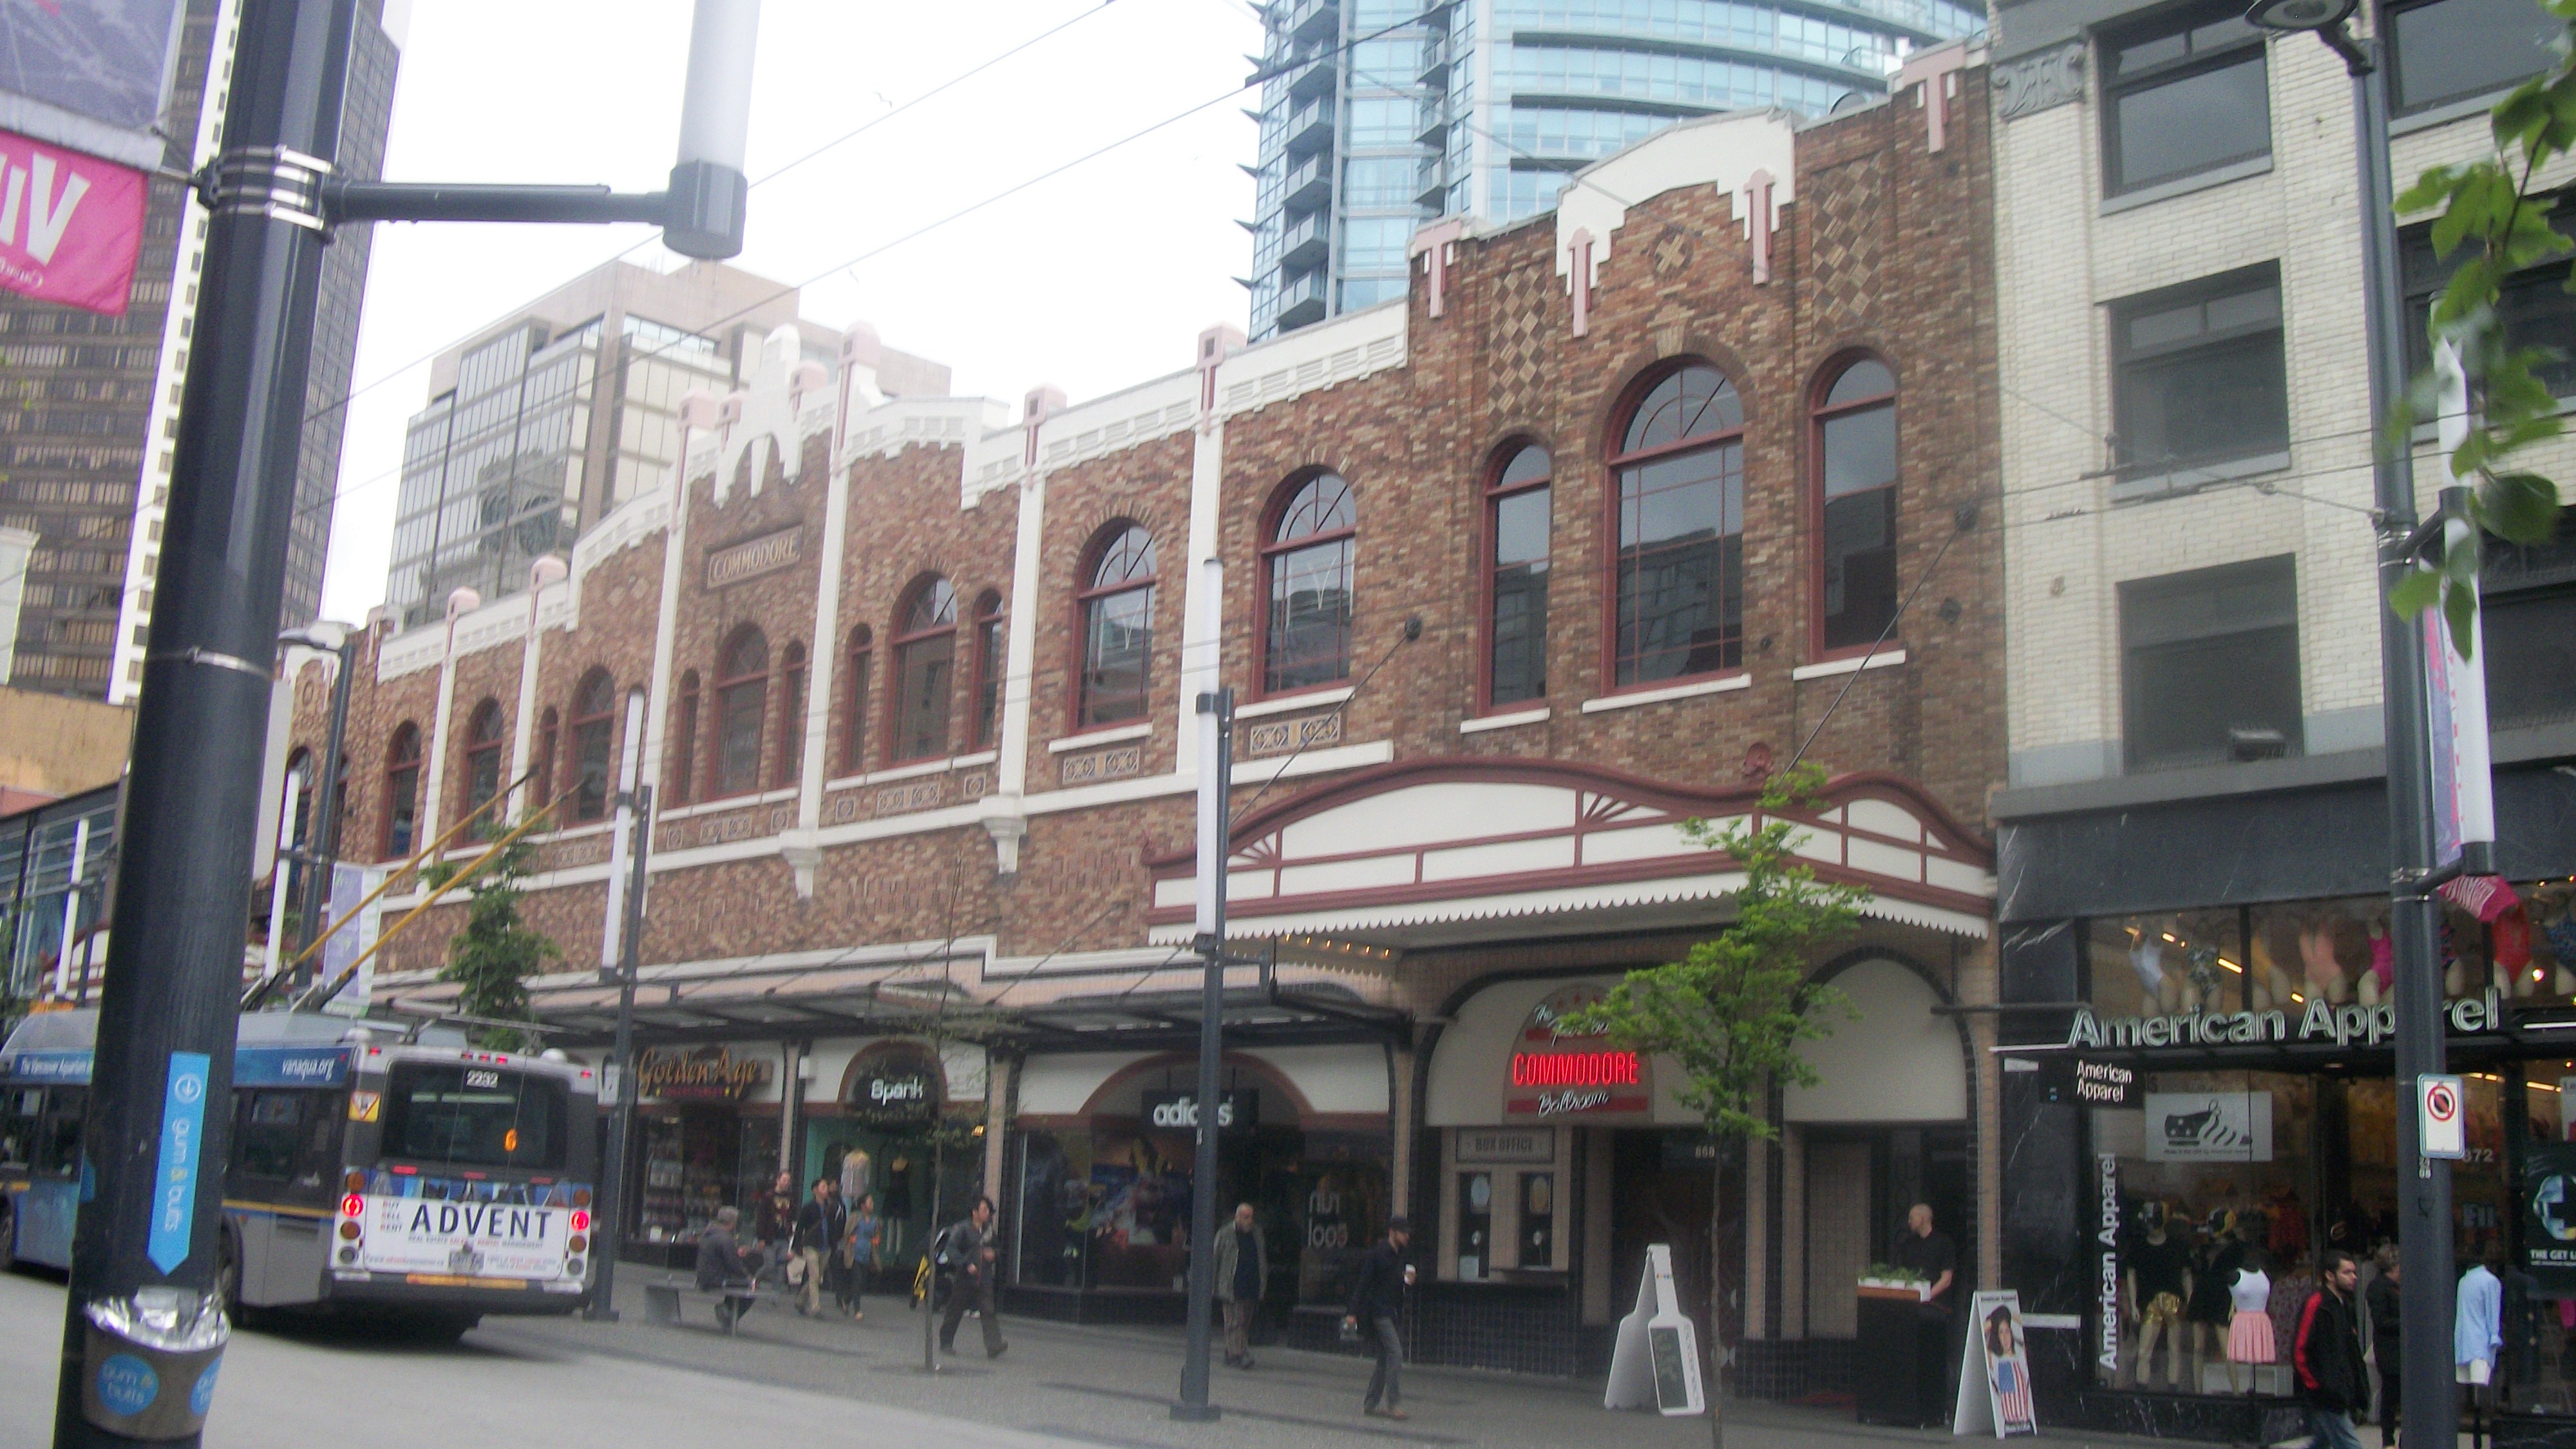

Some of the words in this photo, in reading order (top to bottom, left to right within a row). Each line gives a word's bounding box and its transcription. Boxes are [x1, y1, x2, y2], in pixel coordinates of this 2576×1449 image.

[2069, 1003, 2286, 1048] American
[2298, 986, 2501, 1046] Appel
[638, 1046, 708, 1096] Golden
[714, 1045, 758, 1099] Age
[1514, 1051, 1639, 1086] COMMODORE
[2076, 1059, 2133, 1084] American
[1537, 1090, 1609, 1117] Ballroom
[2077, 1078, 2124, 1103] Apparel
[1153, 1095, 1234, 1127] adis
[2098, 1153, 2120, 1248] Apparel
[410, 1203, 553, 1238] ADVENT
[2099, 1251, 2117, 1371] American
